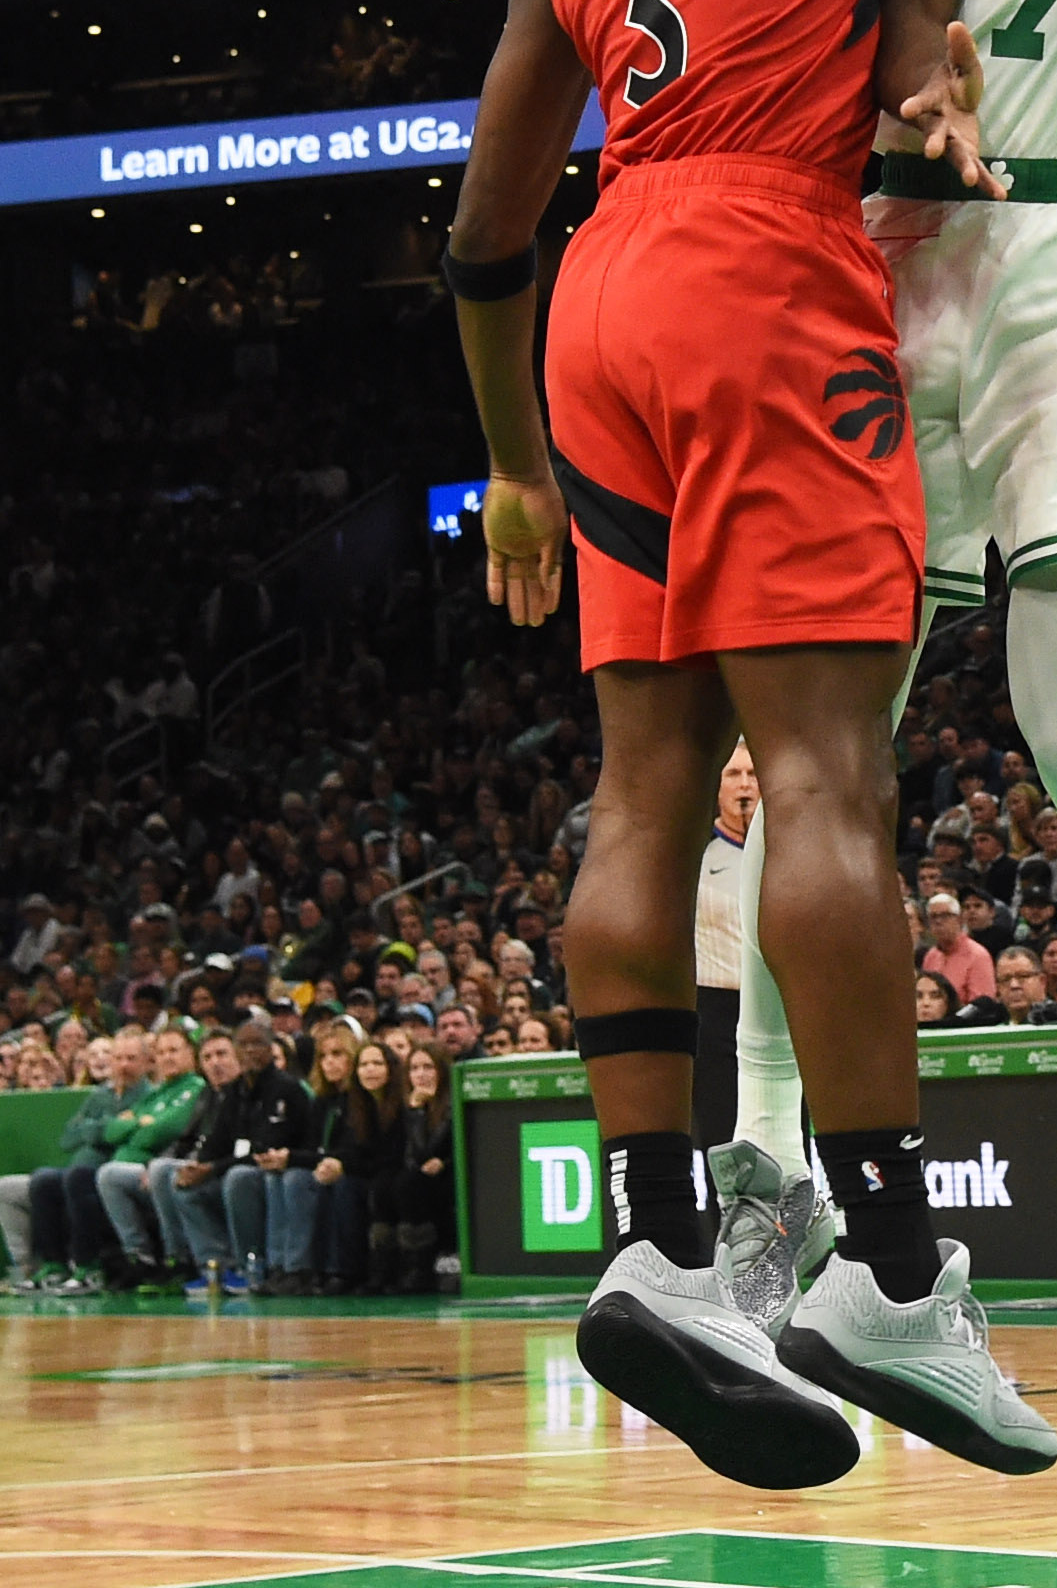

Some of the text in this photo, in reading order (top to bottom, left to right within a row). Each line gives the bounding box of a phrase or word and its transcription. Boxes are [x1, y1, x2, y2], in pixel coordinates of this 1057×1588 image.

[100, 144, 209, 182] Learn
[218, 133, 321, 170] More
[328, 125, 370, 160] at
[528, 1146, 593, 1224] TD
[921, 1142, 1012, 1208] ank
